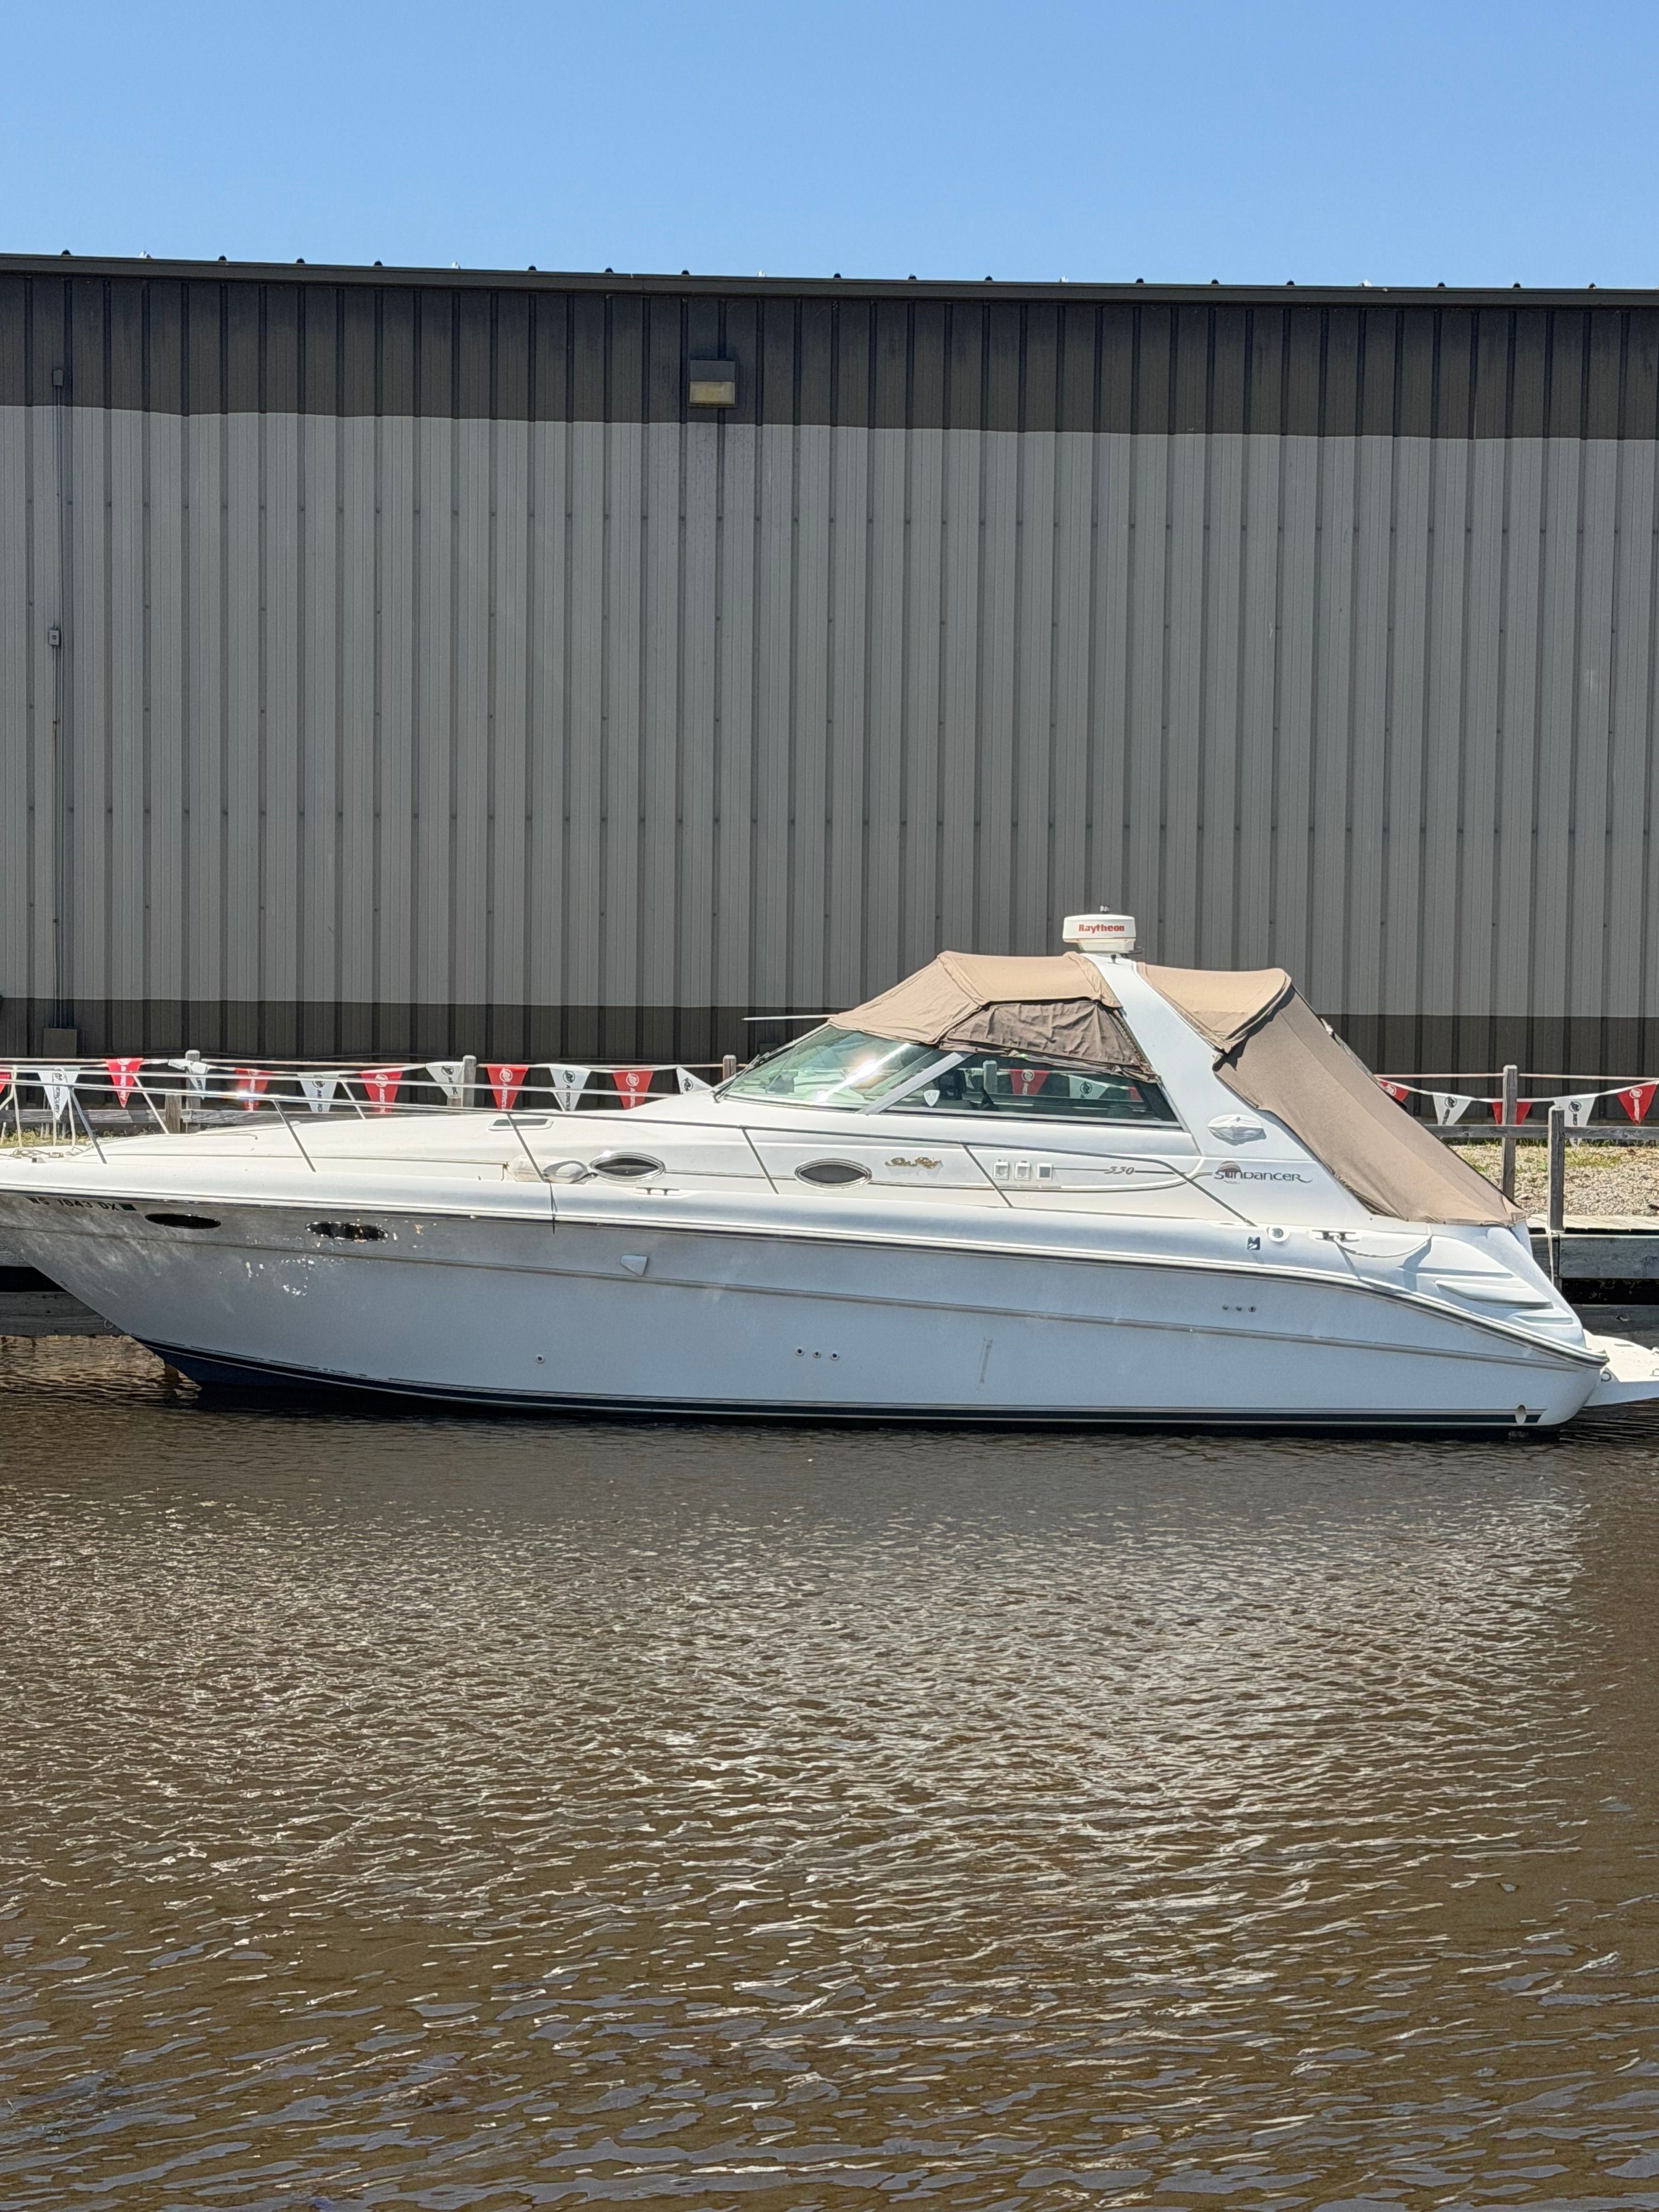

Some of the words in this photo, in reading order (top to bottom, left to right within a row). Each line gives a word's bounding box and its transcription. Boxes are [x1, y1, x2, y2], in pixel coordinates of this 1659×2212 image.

[1079, 924, 1125, 933] Raytheon
[1104, 1166, 1135, 1175] 330
[97, 1201, 120, 1211] DX
